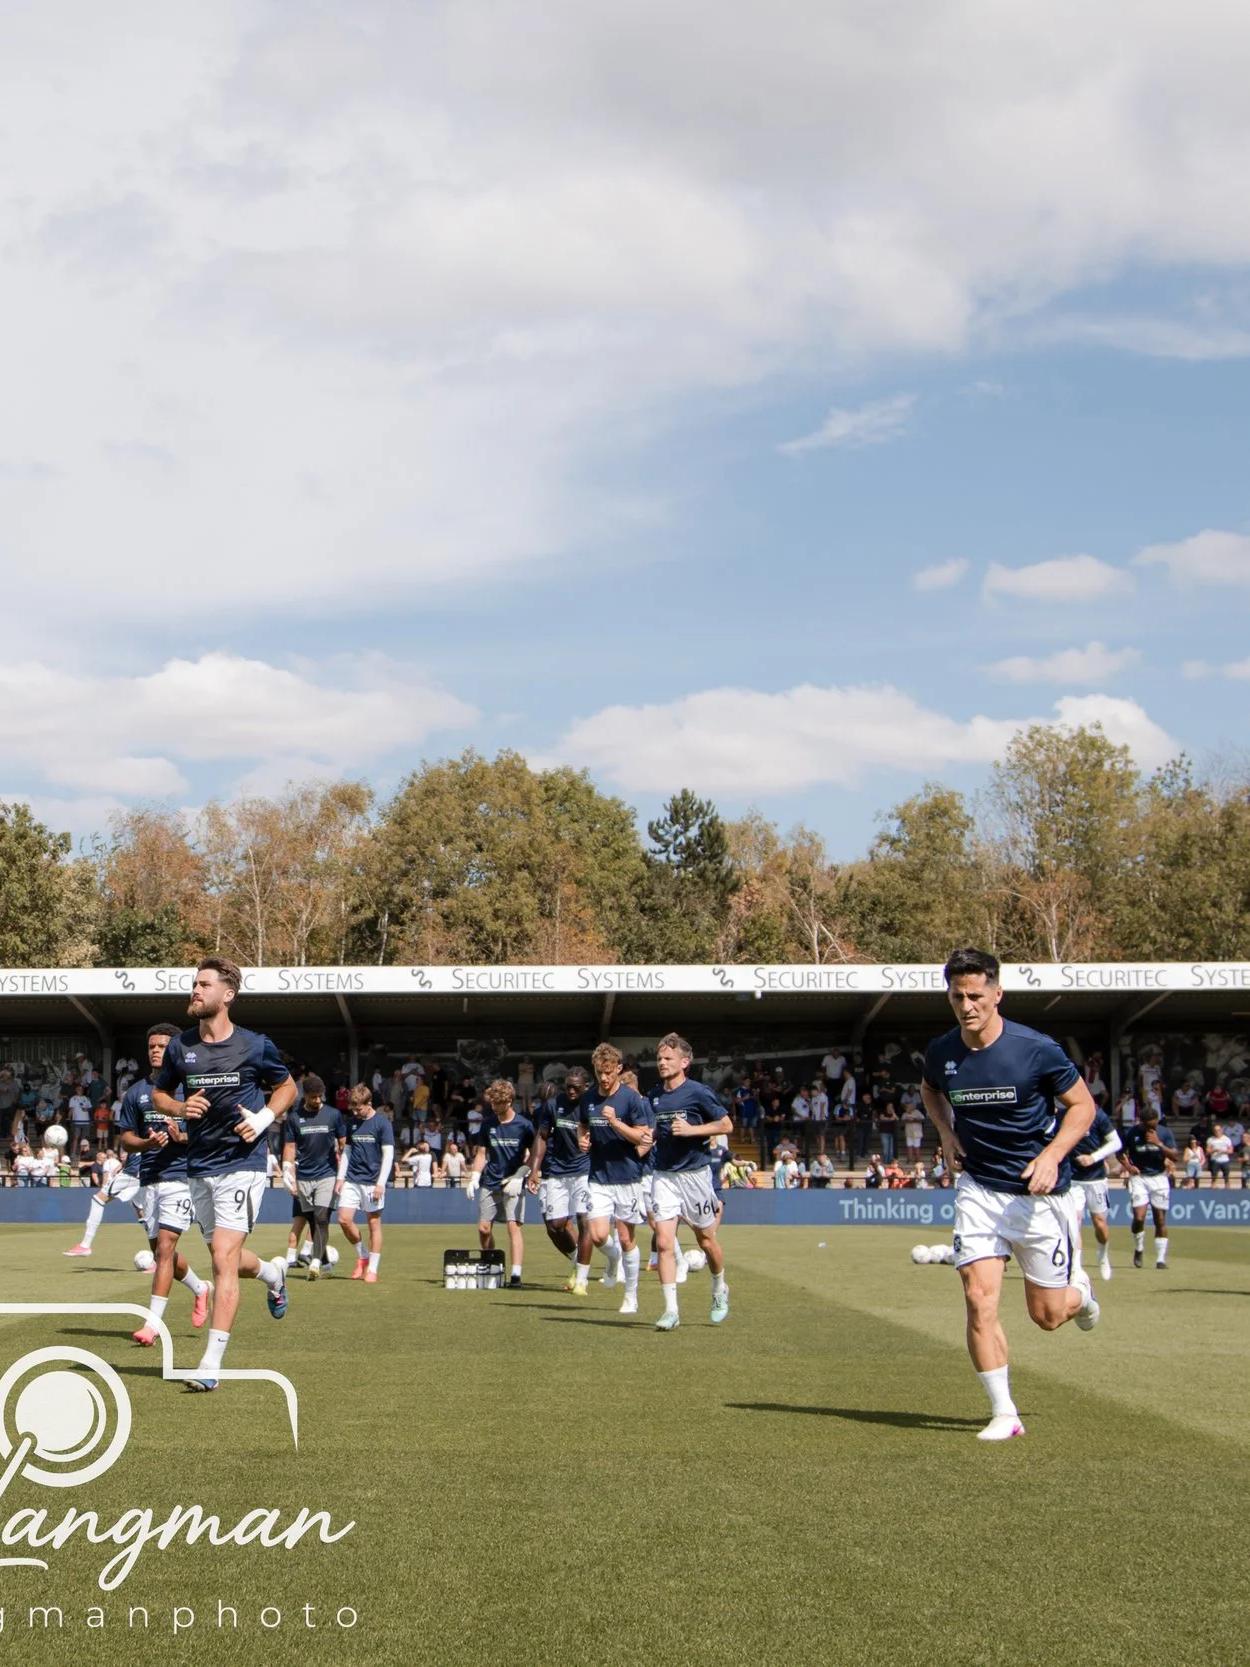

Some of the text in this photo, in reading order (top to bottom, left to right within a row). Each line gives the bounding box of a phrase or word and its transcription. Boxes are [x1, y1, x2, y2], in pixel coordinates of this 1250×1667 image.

[278, 969, 365, 991] SYSTEMS
[452, 968, 665, 990] SECURITEC SYSTEMS
[754, 967, 945, 989] SECURITEC SYSTE
[1061, 965, 1250, 987] SECURITEC SYSTE
[189, 1075, 238, 1085] enterprise
[954, 1090, 1015, 1102] enterprise
[234, 1189, 246, 1213] 9
[695, 1200, 710, 1216] 16
[839, 1198, 933, 1224] Thinking
[1171, 1200, 1250, 1219] or Van?
[1052, 1239, 1065, 1267] 6
